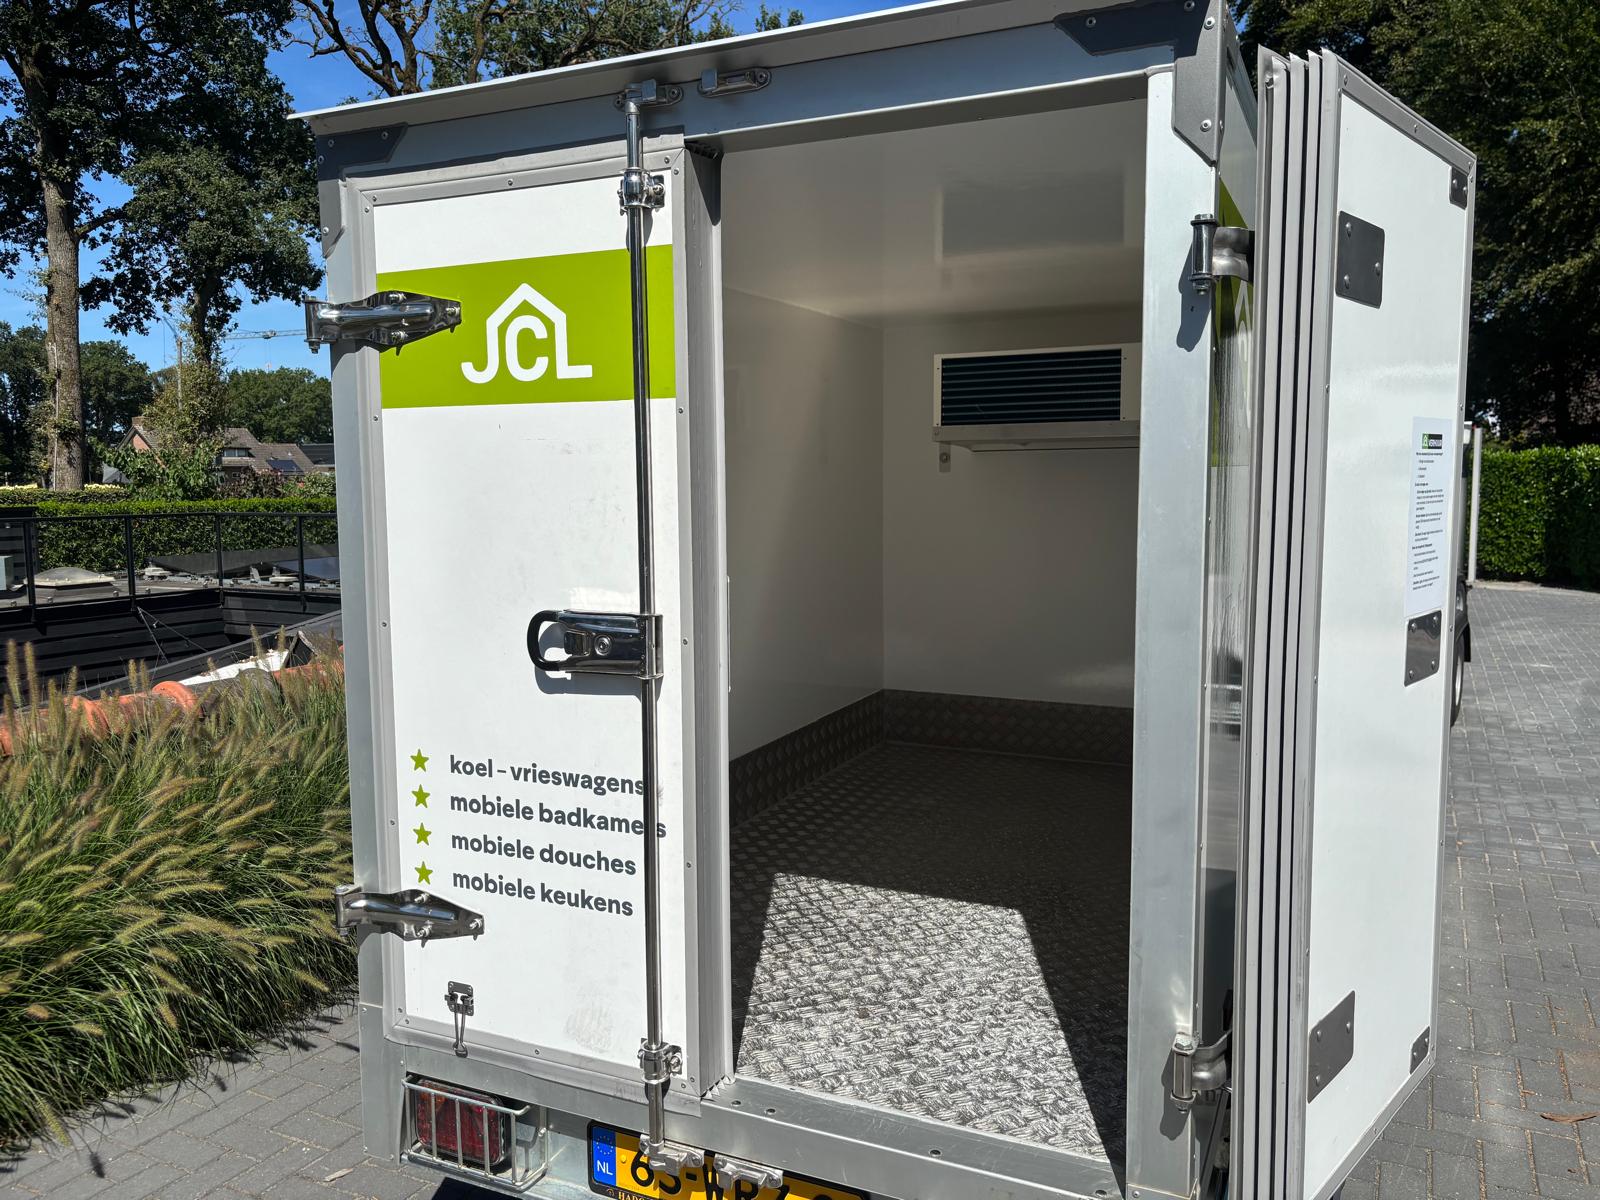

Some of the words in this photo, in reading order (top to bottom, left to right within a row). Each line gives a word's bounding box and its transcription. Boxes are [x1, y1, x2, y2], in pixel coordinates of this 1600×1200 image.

[461, 283, 592, 384] JCL
[450, 754, 493, 778] koel
[450, 794, 534, 821] mobiele
[539, 802, 667, 839] badkames
[452, 833, 535, 860] mobiele
[539, 843, 637, 876] douches
[453, 871, 536, 900] mobiele
[540, 882, 634, 917] keukens
[596, 1160, 613, 1176] NL
